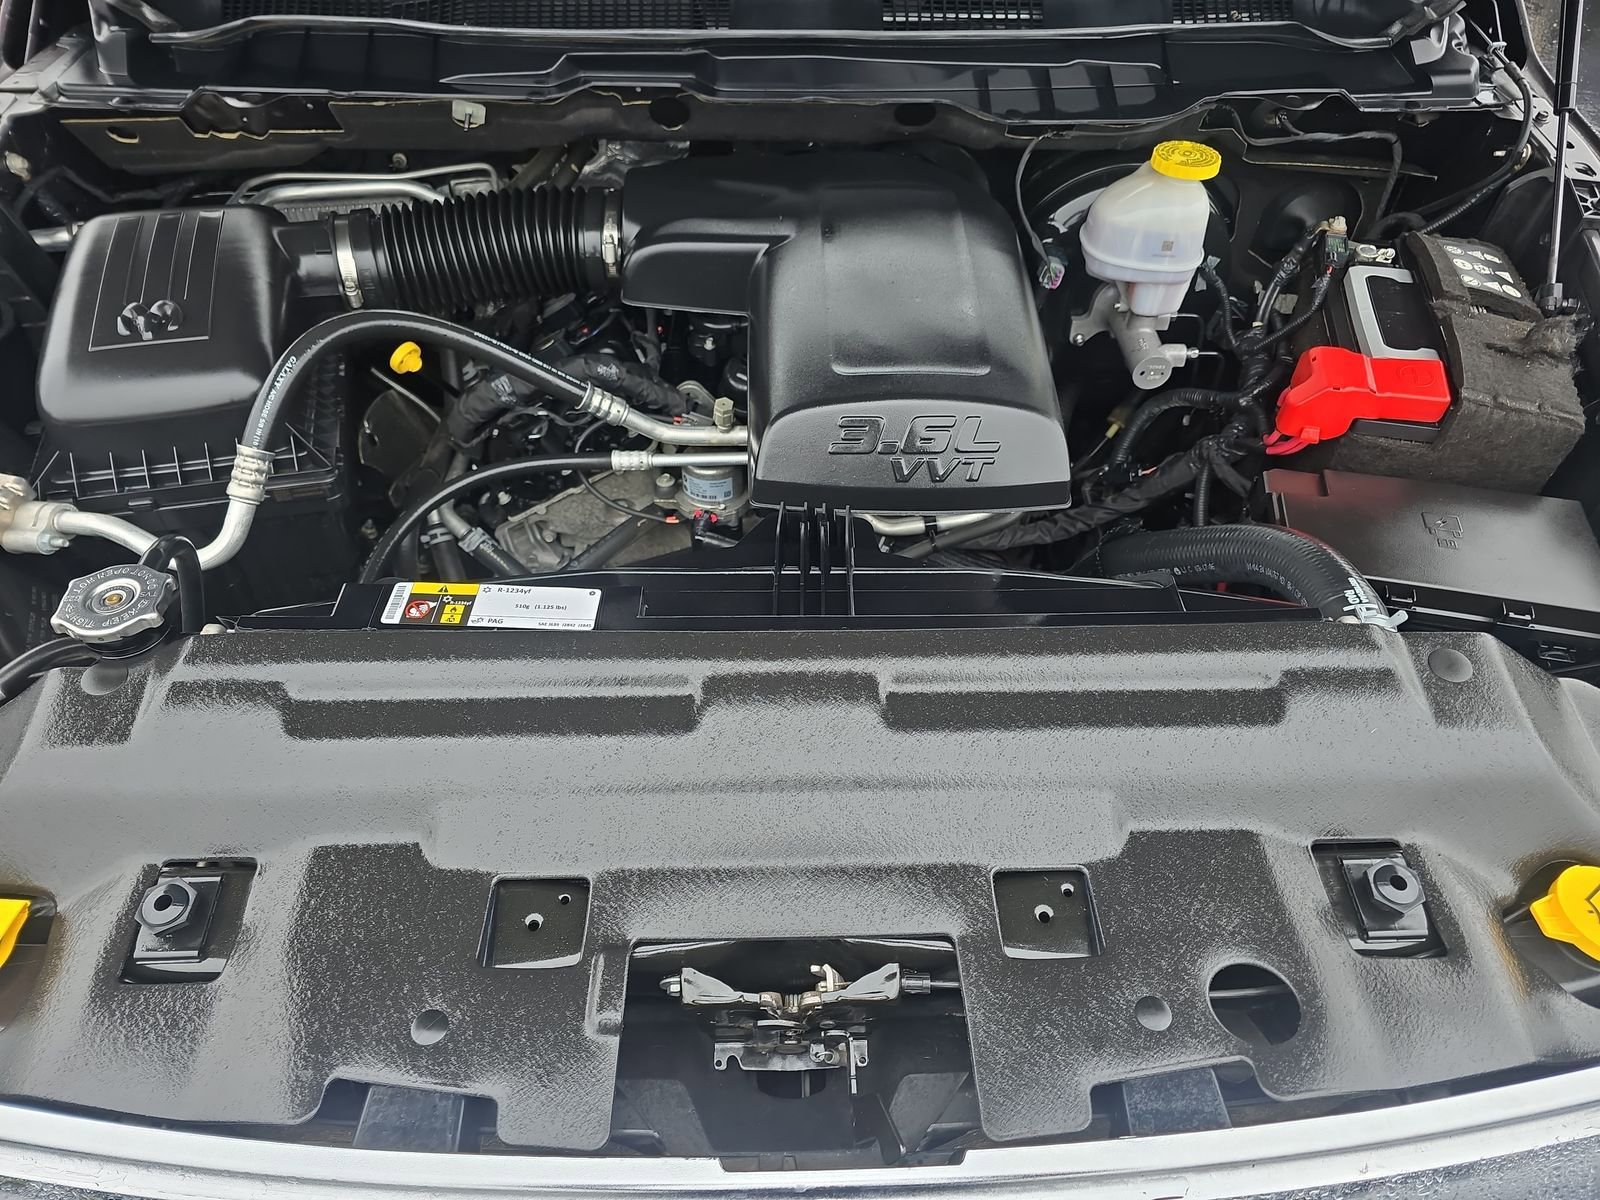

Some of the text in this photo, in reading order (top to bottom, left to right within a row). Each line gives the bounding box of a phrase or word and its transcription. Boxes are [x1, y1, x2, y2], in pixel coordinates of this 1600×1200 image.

[274, 356, 297, 389] GALAXY
[268, 388, 277, 400] A/C
[261, 399, 273, 418] HOSE
[828, 415, 1001, 454] 3.6L
[890, 457, 995, 483] VVT
[96, 567, 130, 579] OPEN
[130, 568, 151, 580] NOT
[73, 576, 96, 594] HOT
[497, 587, 532, 595] R-1234yf
[1343, 589, 1360, 605] RAD
[102, 608, 136, 627] KEEP
